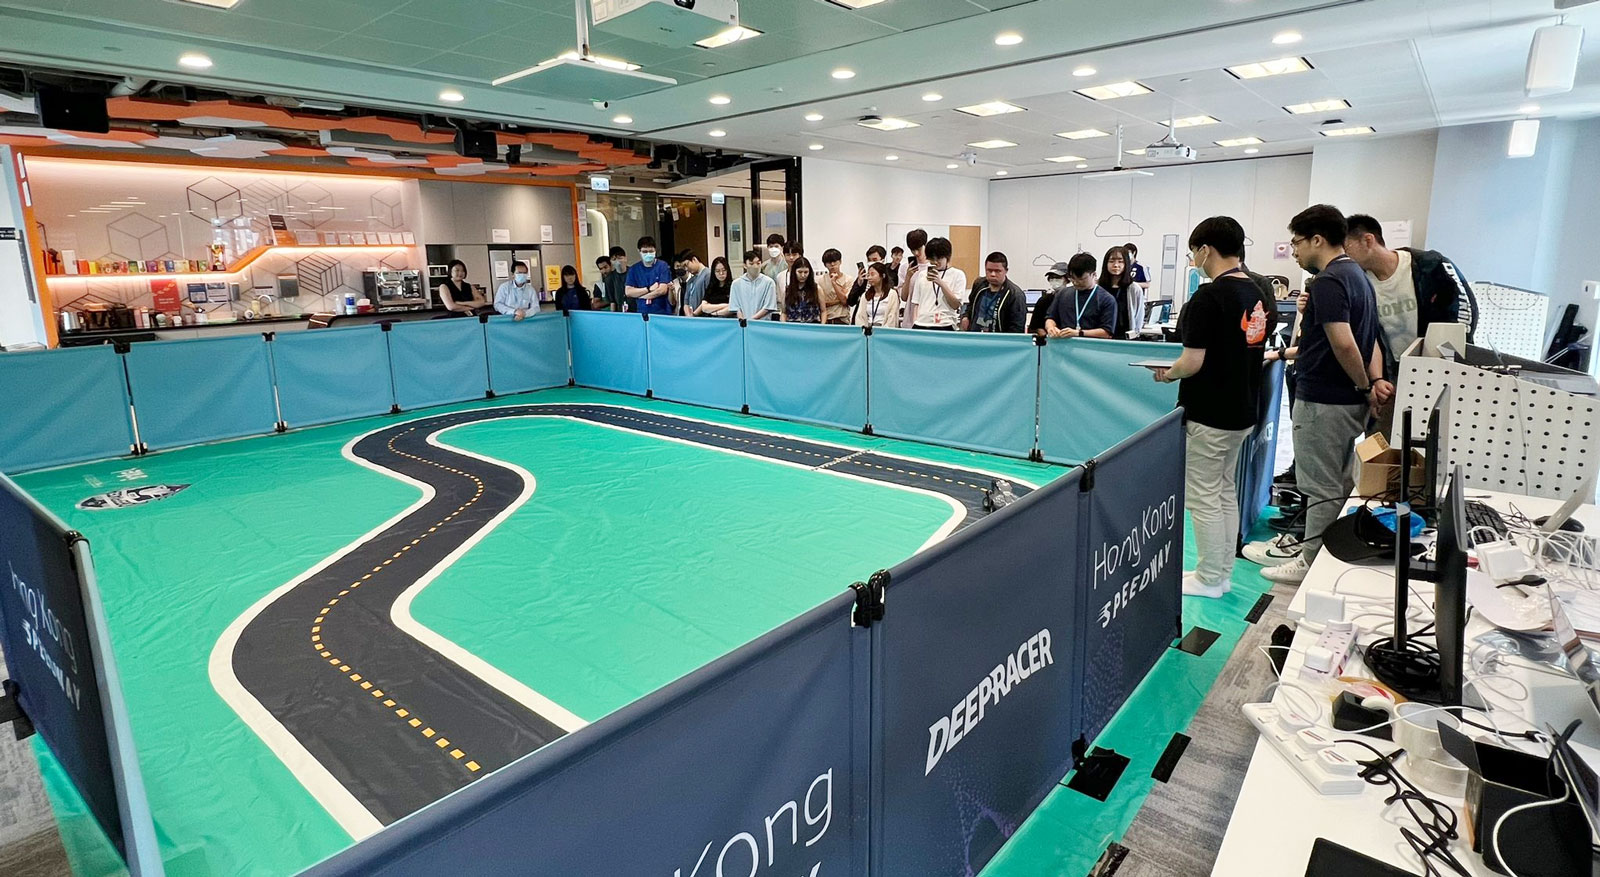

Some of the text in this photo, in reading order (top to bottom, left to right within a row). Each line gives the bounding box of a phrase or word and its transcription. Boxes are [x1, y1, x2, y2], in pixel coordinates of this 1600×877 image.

[1093, 494, 1175, 590] Hong Kong
[1097, 540, 1171, 628] SPEEDWAY
[925, 628, 1053, 776] DEEPRACER
